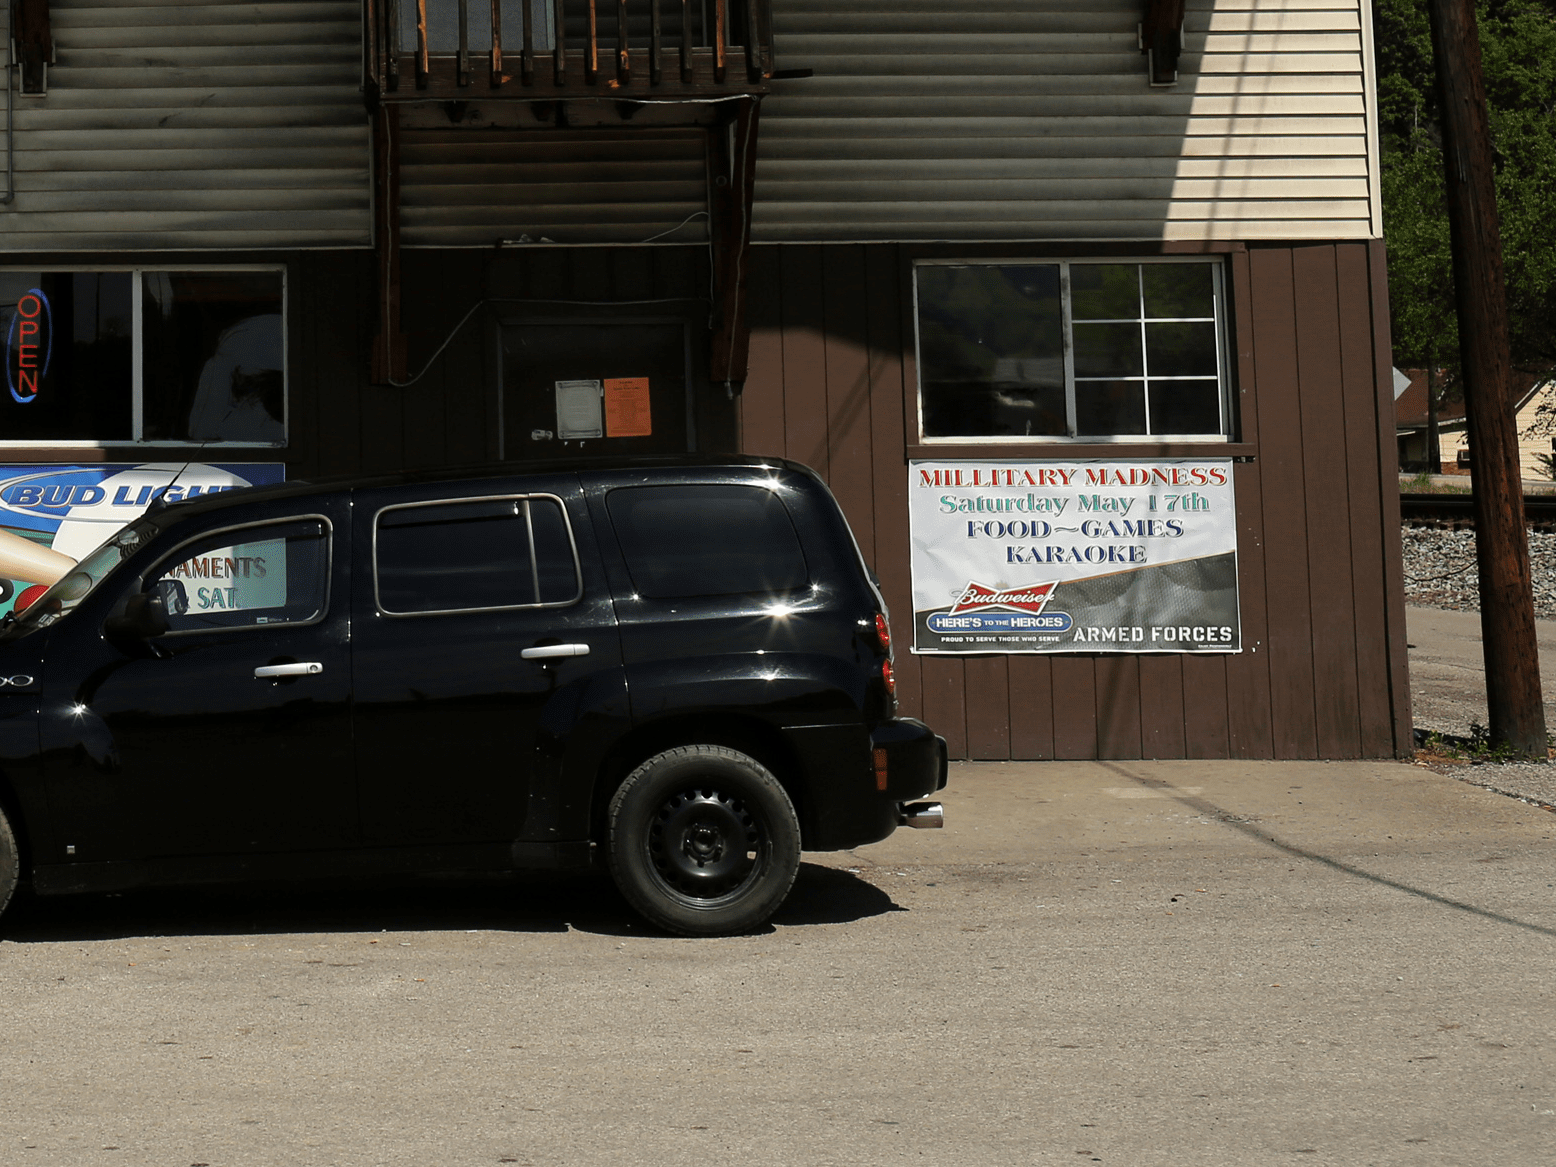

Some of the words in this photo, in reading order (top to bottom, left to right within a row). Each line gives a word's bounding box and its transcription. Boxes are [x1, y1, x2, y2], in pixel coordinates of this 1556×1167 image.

[17, 294, 41, 394] OPEN
[919, 467, 1078, 488] MILLITARY
[1085, 466, 1228, 487] MADNESS
[7, 484, 107, 506] BUD
[939, 493, 1069, 517] Saturday
[1078, 493, 1136, 517] May
[1148, 491, 1210, 512] 17th
[1006, 544, 1148, 564] KARAOKE
[162, 556, 266, 579] AMENTS
[952, 588, 1055, 605] Budweiser
[936, 617, 982, 628] HERE'S
[1010, 617, 1064, 627] HEROES
[1073, 626, 1144, 642] ARMED
[1151, 626, 1233, 642] FORCES
